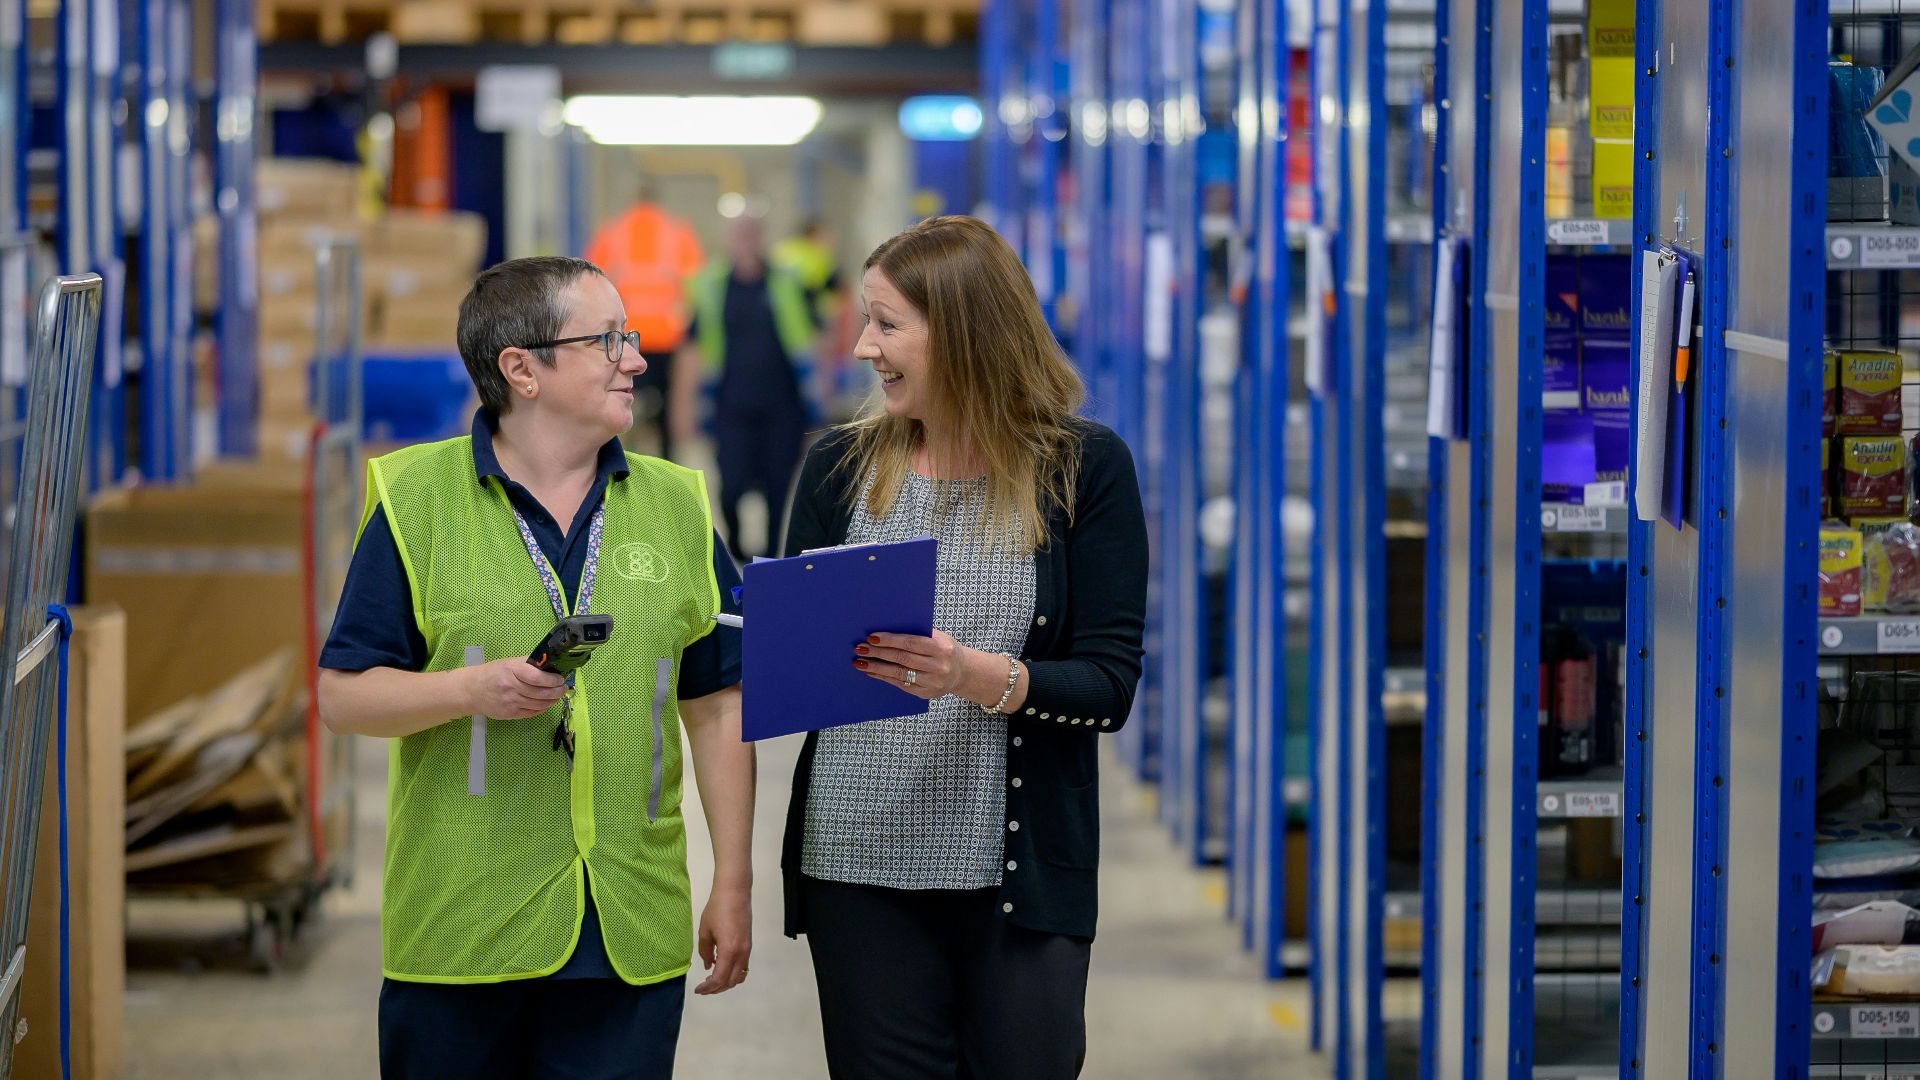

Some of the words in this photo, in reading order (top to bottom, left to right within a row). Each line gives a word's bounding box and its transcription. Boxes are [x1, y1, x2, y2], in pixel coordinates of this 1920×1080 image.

[1867, 237, 1919, 251] D05-050
[1848, 358, 1896, 373] Anadin
[1854, 372, 1889, 381] EXTRA
[1851, 441, 1897, 454] Anadin
[1856, 455, 1892, 464] EXTRA
[1572, 795, 1610, 806] E05-150
[1858, 1011, 1910, 1023] D05-150
